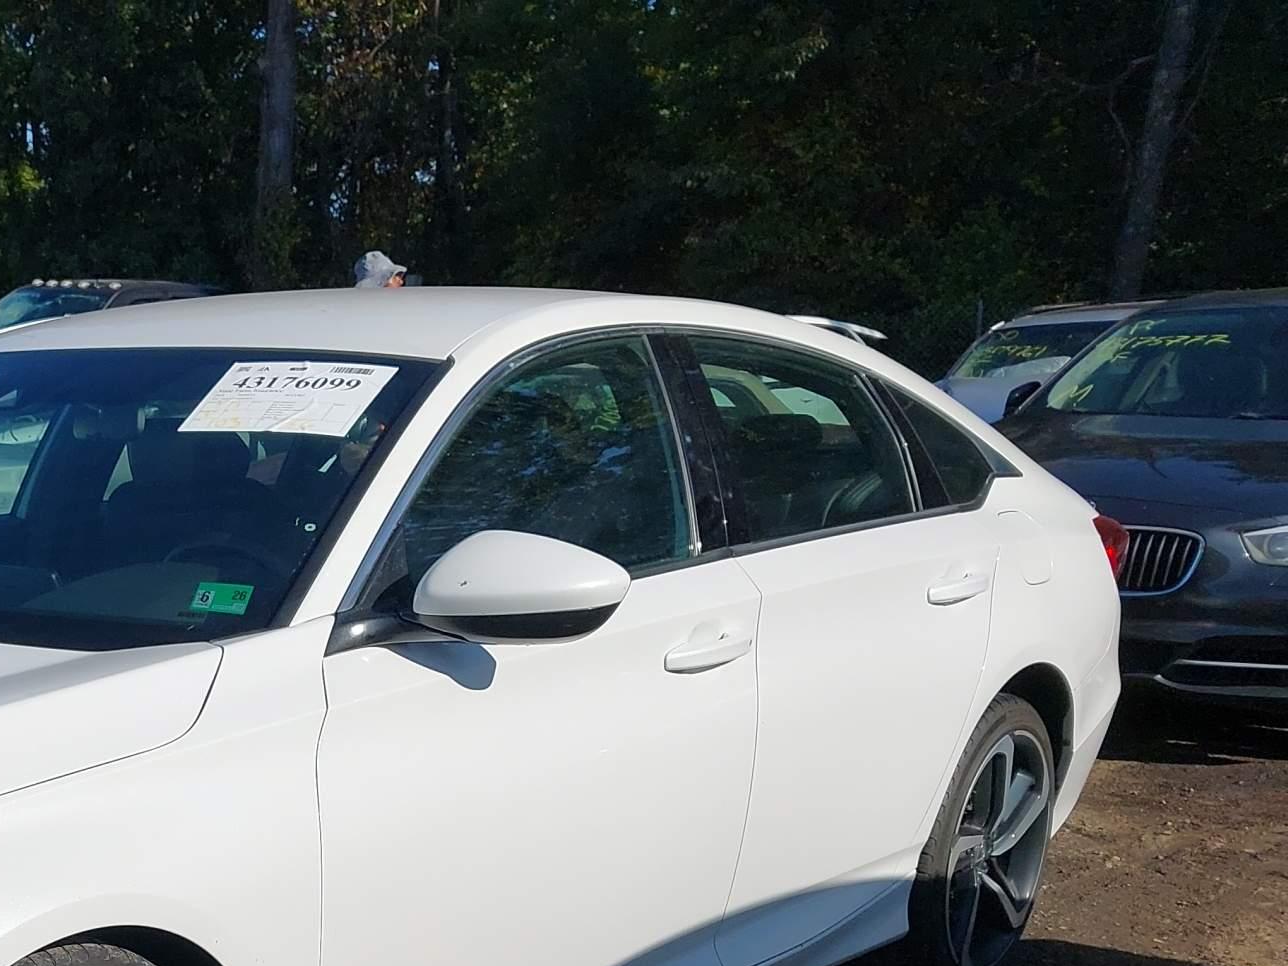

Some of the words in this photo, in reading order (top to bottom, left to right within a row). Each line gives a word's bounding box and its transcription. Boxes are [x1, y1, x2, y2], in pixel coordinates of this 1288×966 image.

[233, 376, 362, 391] 43176099
[200, 590, 211, 603] 6
[232, 590, 248, 601] 26
